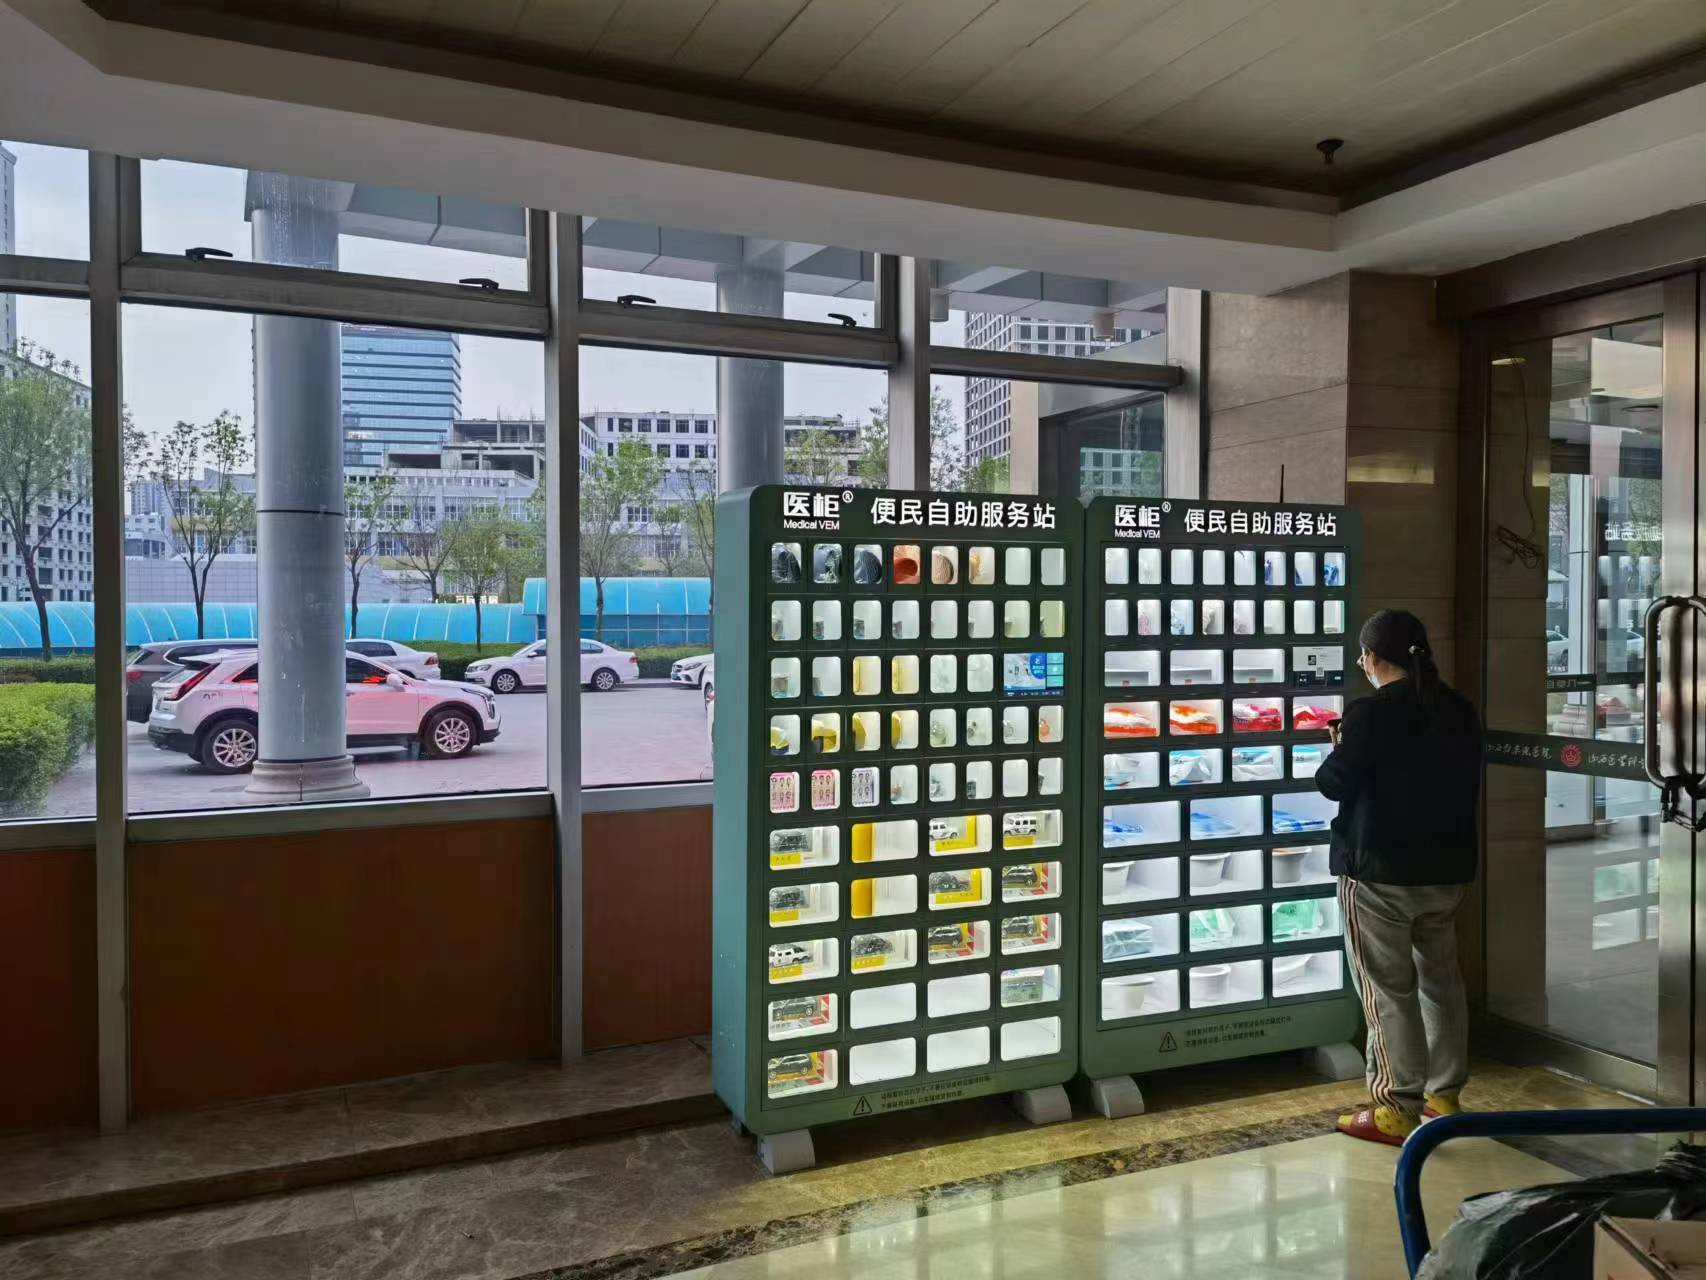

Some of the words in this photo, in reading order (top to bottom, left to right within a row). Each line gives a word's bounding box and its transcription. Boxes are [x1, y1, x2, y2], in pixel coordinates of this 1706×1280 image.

[870, 497, 1056, 530] 便民自助服务站
[1184, 508, 1337, 537] 便民自助服务站
[783, 519, 817, 530] Medical
[818, 520, 840, 531] VEM
[1114, 528, 1142, 538] Medical
[1143, 529, 1161, 539] VEM
